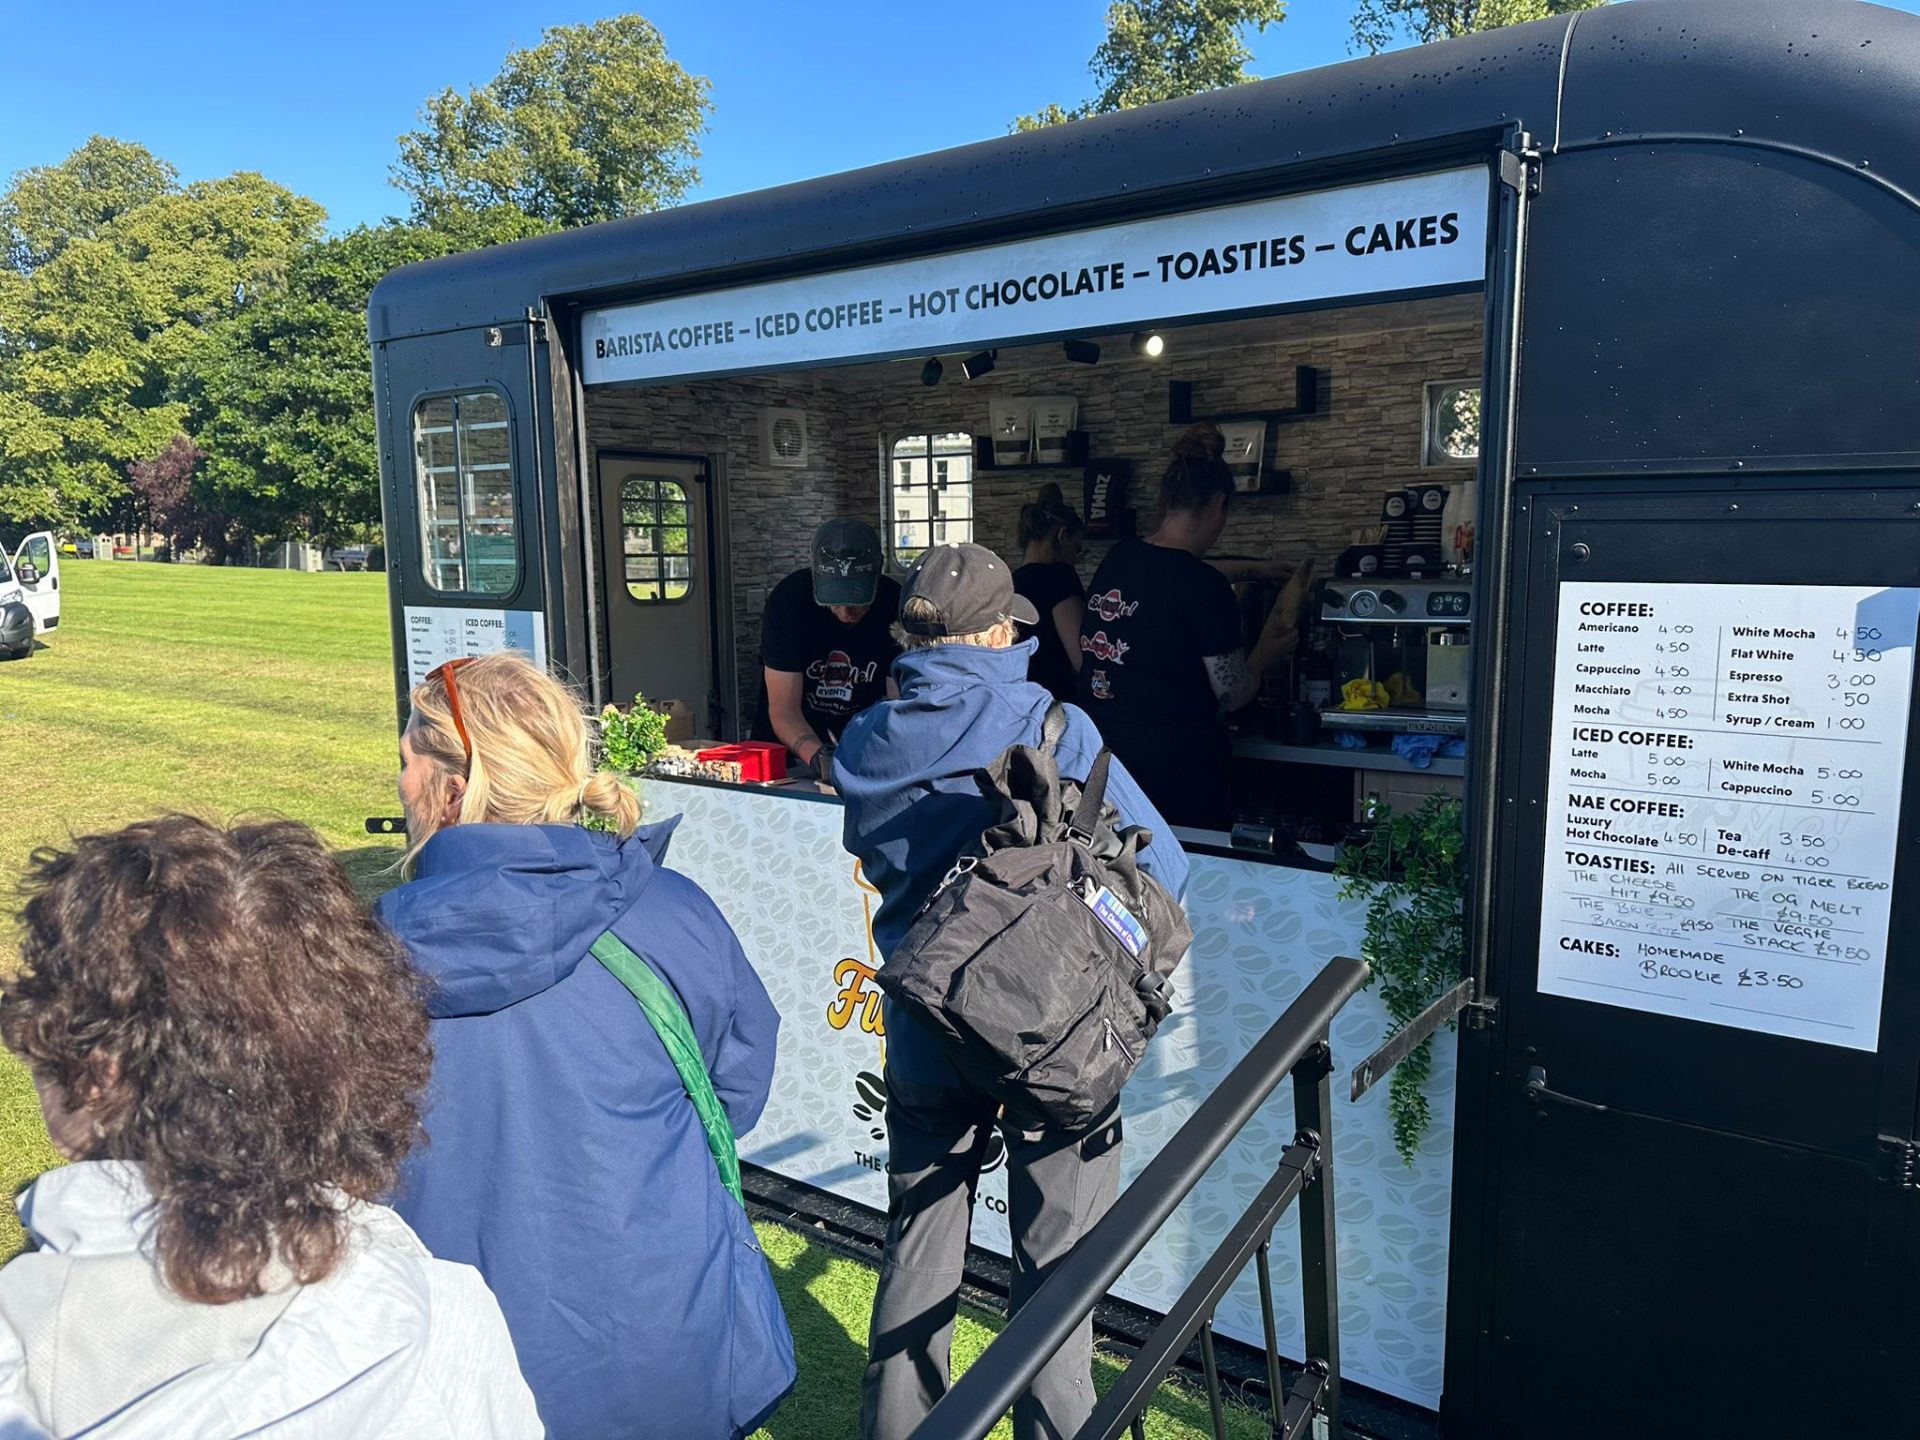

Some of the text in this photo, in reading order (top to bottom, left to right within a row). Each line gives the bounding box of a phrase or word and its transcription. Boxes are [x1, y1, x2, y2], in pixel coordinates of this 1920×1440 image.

[596, 331, 665, 358] BARISTA
[668, 321, 734, 348] COFFEE
[756, 312, 800, 339] ICED
[805, 300, 883, 332] COFFEE
[909, 287, 960, 319] HOT
[965, 263, 1124, 306] CHOCOLATE
[1157, 235, 1305, 282] TOASTIES
[1345, 213, 1459, 256] CAKES
[1579, 602, 1654, 618] COFFEE:
[411, 616, 432, 624] COFFEE:
[480, 620, 504, 628] COFFEE:
[1578, 622, 1639, 634] Americano
[1732, 627, 1770, 639] White
[1773, 628, 1815, 640] Mocha
[1578, 642, 1605, 653] Latte
[1731, 649, 1753, 660] Flat
[1756, 650, 1794, 661] White
[1576, 664, 1641, 677] Cappuccino
[1729, 671, 1782, 684] Espresso
[1575, 685, 1631, 696] Macchiato
[1728, 693, 1760, 704] Extra
[1762, 694, 1790, 706] Shot
[1574, 705, 1610, 716] Mocha
[1726, 713, 1762, 727] Syrup
[1775, 716, 1815, 729] Cream
[1572, 727, 1693, 750] ICED COFFEE:
[1572, 748, 1598, 759] Latte
[1570, 768, 1606, 780] Mocha
[1723, 760, 1760, 773] White
[1763, 762, 1804, 776] Mocha
[1721, 781, 1792, 797] Cappuccino
[1568, 794, 1685, 818] NAE COFFEE:
[1567, 814, 1612, 828] Luxury
[1566, 828, 1591, 840] Hot
[1593, 831, 1658, 848] Chocolate
[1718, 829, 1742, 842] Tea
[1717, 844, 1771, 860] De-caff
[1565, 851, 1656, 875] TOASTIES:
[1568, 870, 1676, 892] THE CHEESE
[1697, 865, 1750, 881] SERVED
[1761, 872, 1784, 883] ON
[1792, 875, 1835, 888] TIGER
[1611, 886, 1640, 900] HIT
[1570, 897, 1604, 912] THE
[1730, 887, 1862, 916] THE OG MELT
[1591, 913, 1638, 930] BACON
[1728, 917, 1759, 930] THE
[1559, 937, 1620, 958] CAKES:
[1744, 932, 1806, 952] STACK
[1638, 943, 1725, 964] HOMEMADE
[1639, 960, 1723, 986] BROOKIE
[854, 1151, 881, 1172] THE
